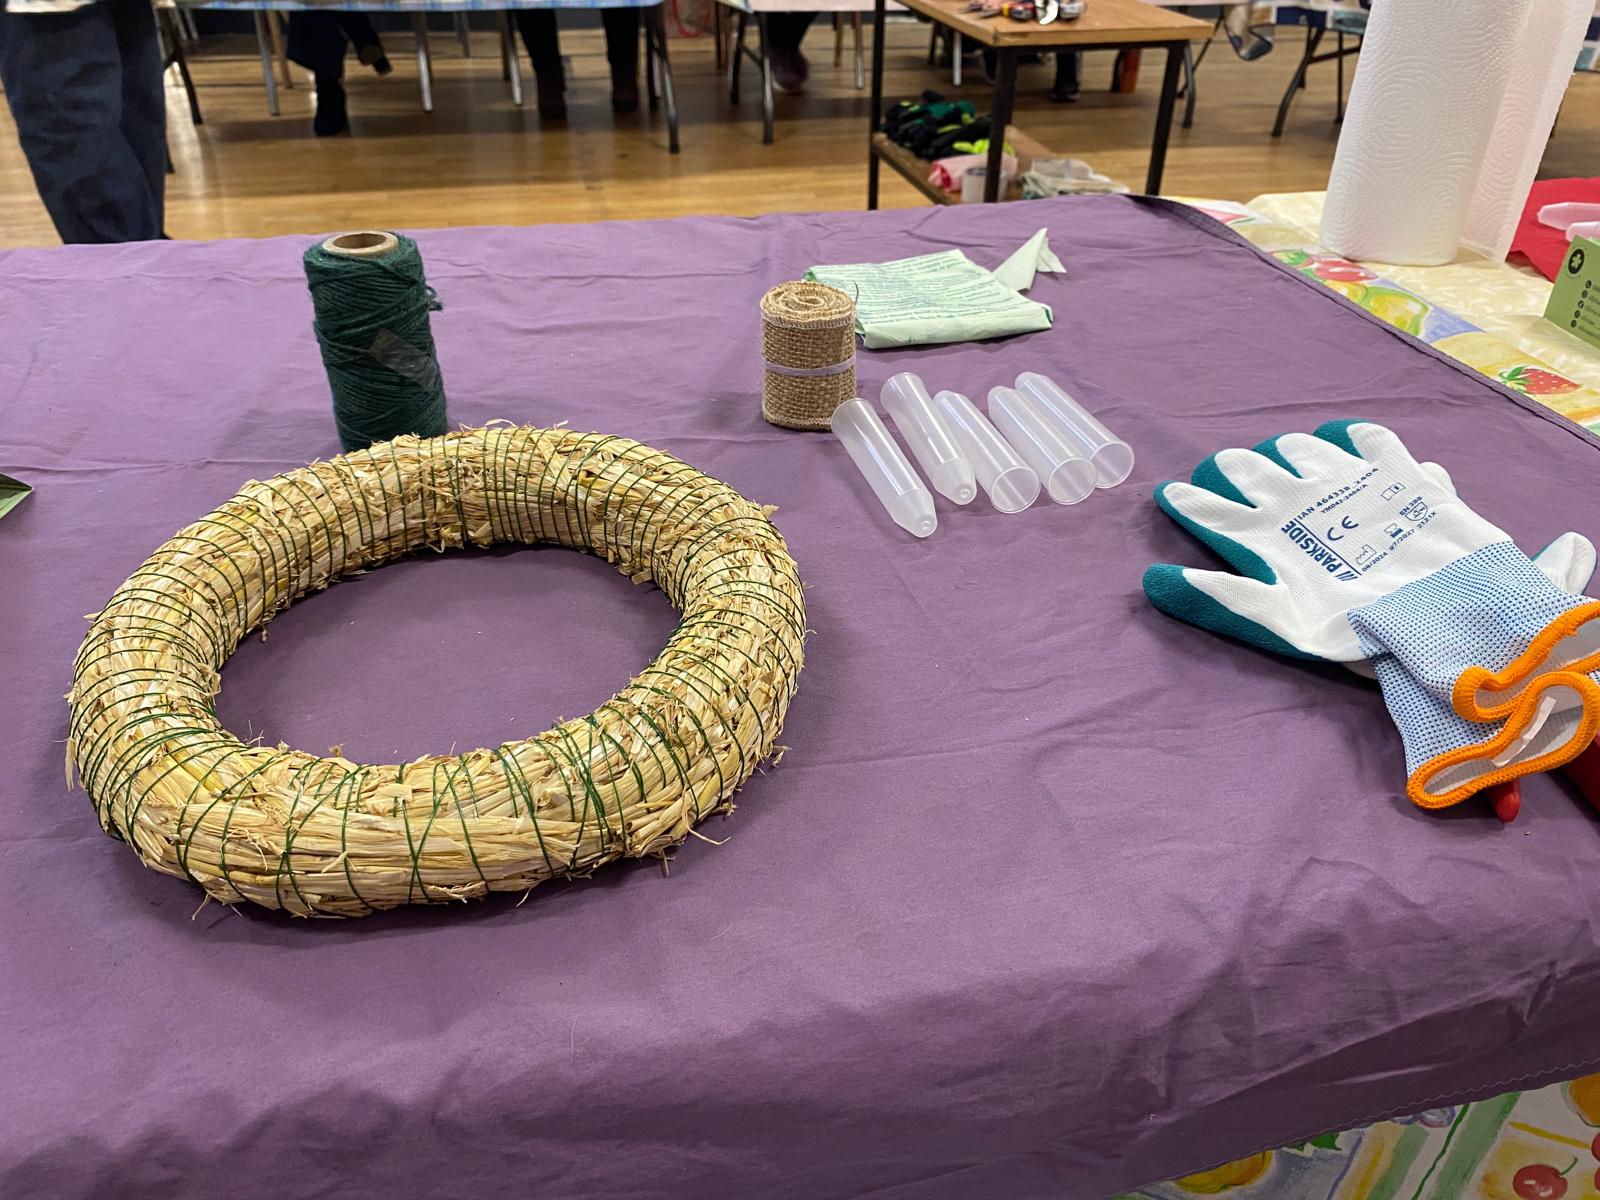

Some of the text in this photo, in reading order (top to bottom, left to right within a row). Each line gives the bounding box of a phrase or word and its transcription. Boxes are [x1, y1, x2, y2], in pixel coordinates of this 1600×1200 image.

[1297, 506, 1315, 520] IAN
[1399, 507, 1410, 516] EN
[1327, 515, 1359, 541] CE
[1281, 520, 1343, 573] PARKSIDE
